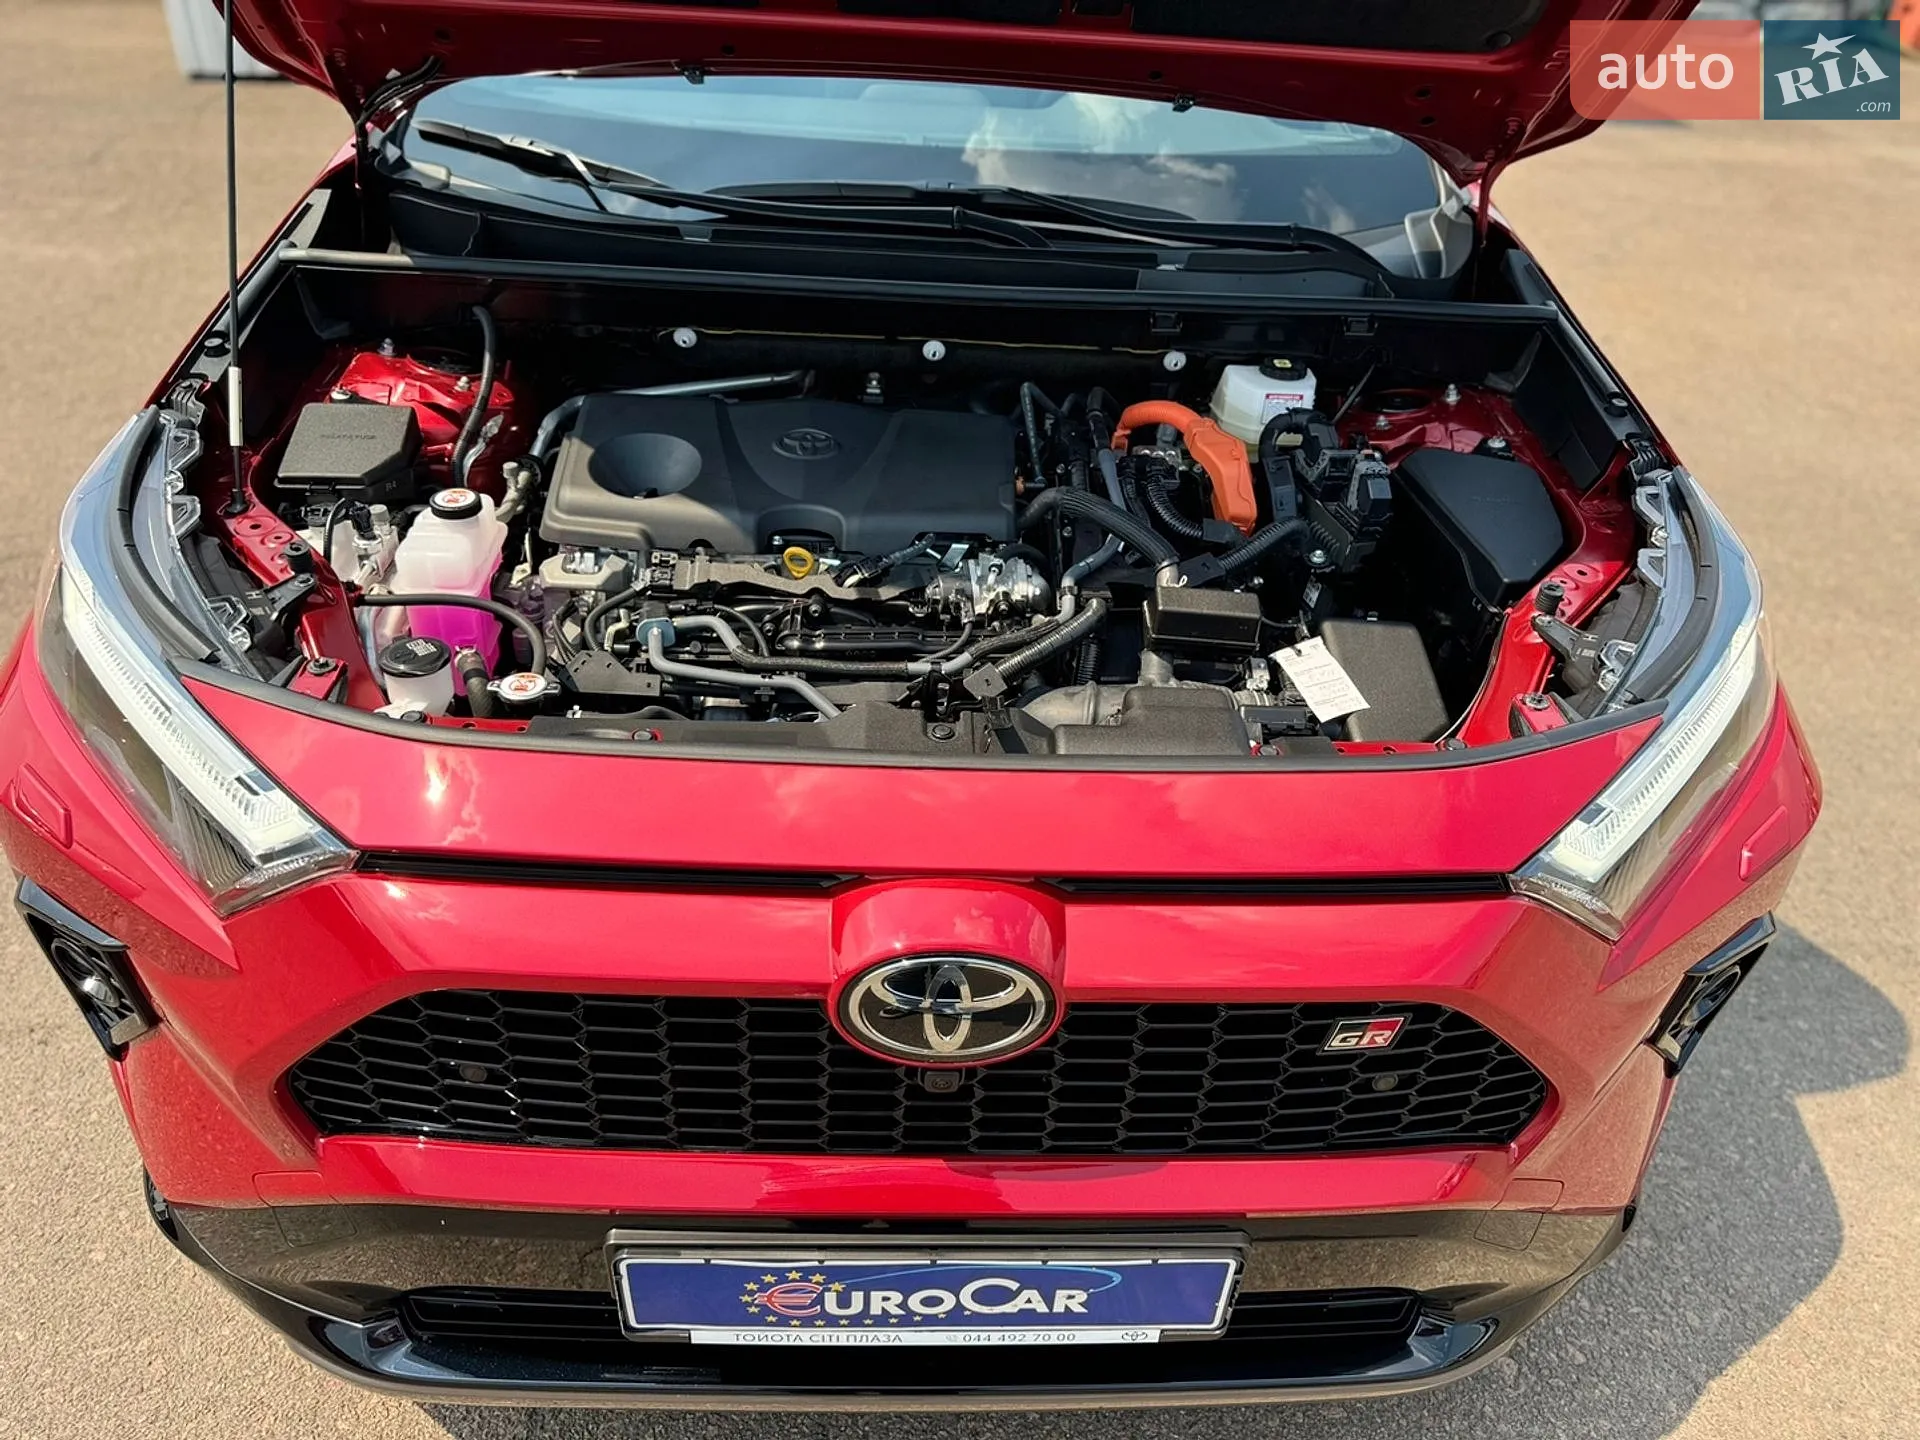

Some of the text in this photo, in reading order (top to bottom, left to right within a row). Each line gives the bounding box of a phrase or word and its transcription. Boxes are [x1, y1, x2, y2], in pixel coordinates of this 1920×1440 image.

[1330, 1030, 1393, 1047] GR
[846, 1332, 903, 1344] ПЛАЗА
[962, 1331, 1076, 1342] 044 492 70 00
